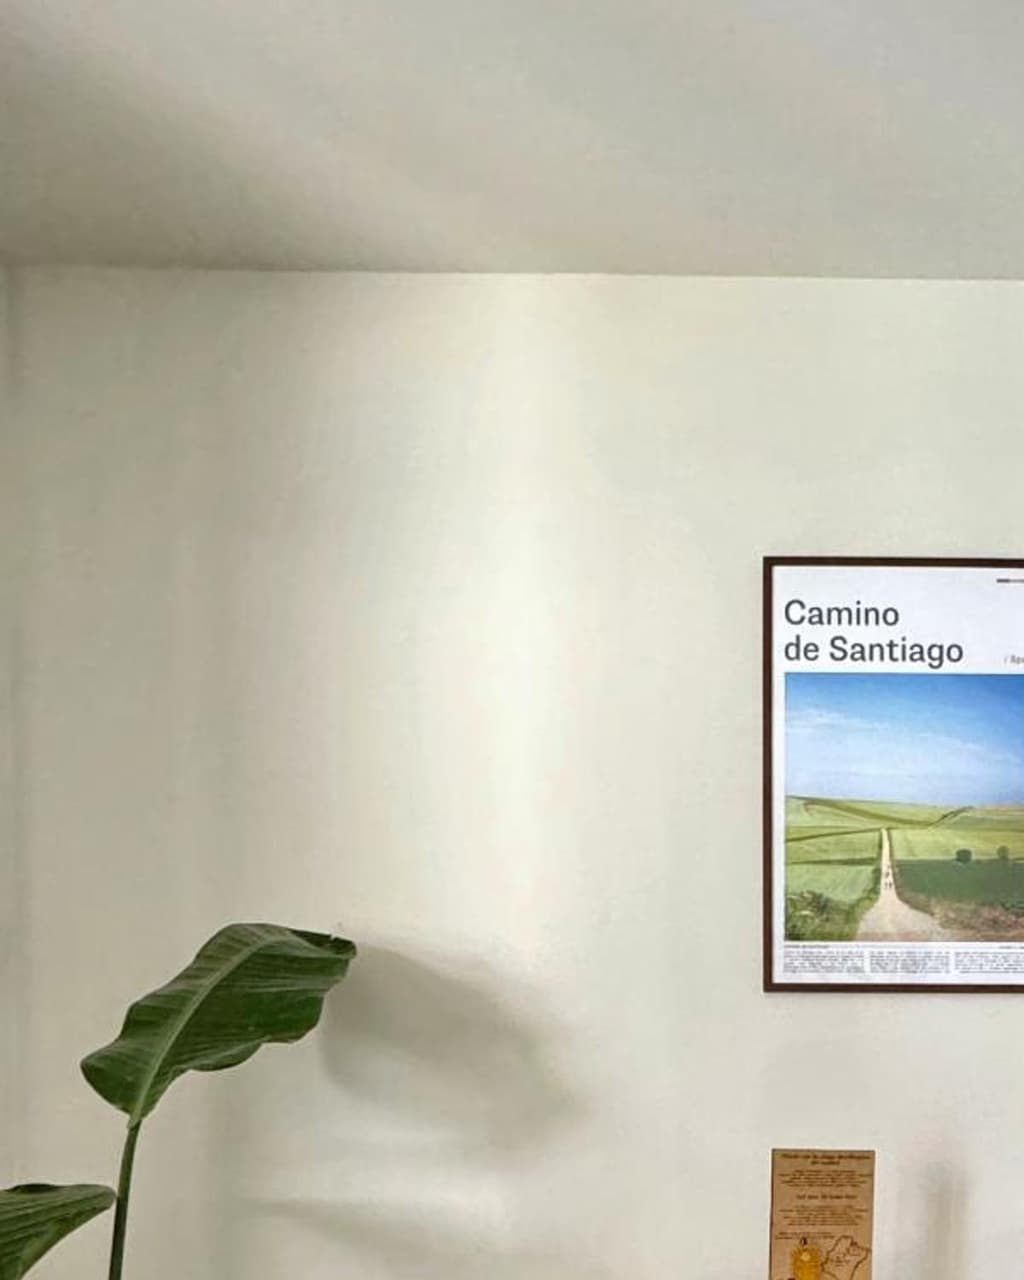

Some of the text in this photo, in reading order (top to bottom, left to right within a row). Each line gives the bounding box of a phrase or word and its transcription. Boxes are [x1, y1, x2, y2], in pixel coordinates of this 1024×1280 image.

[784, 599, 899, 627] Camino
[784, 635, 964, 669] de Santiago
